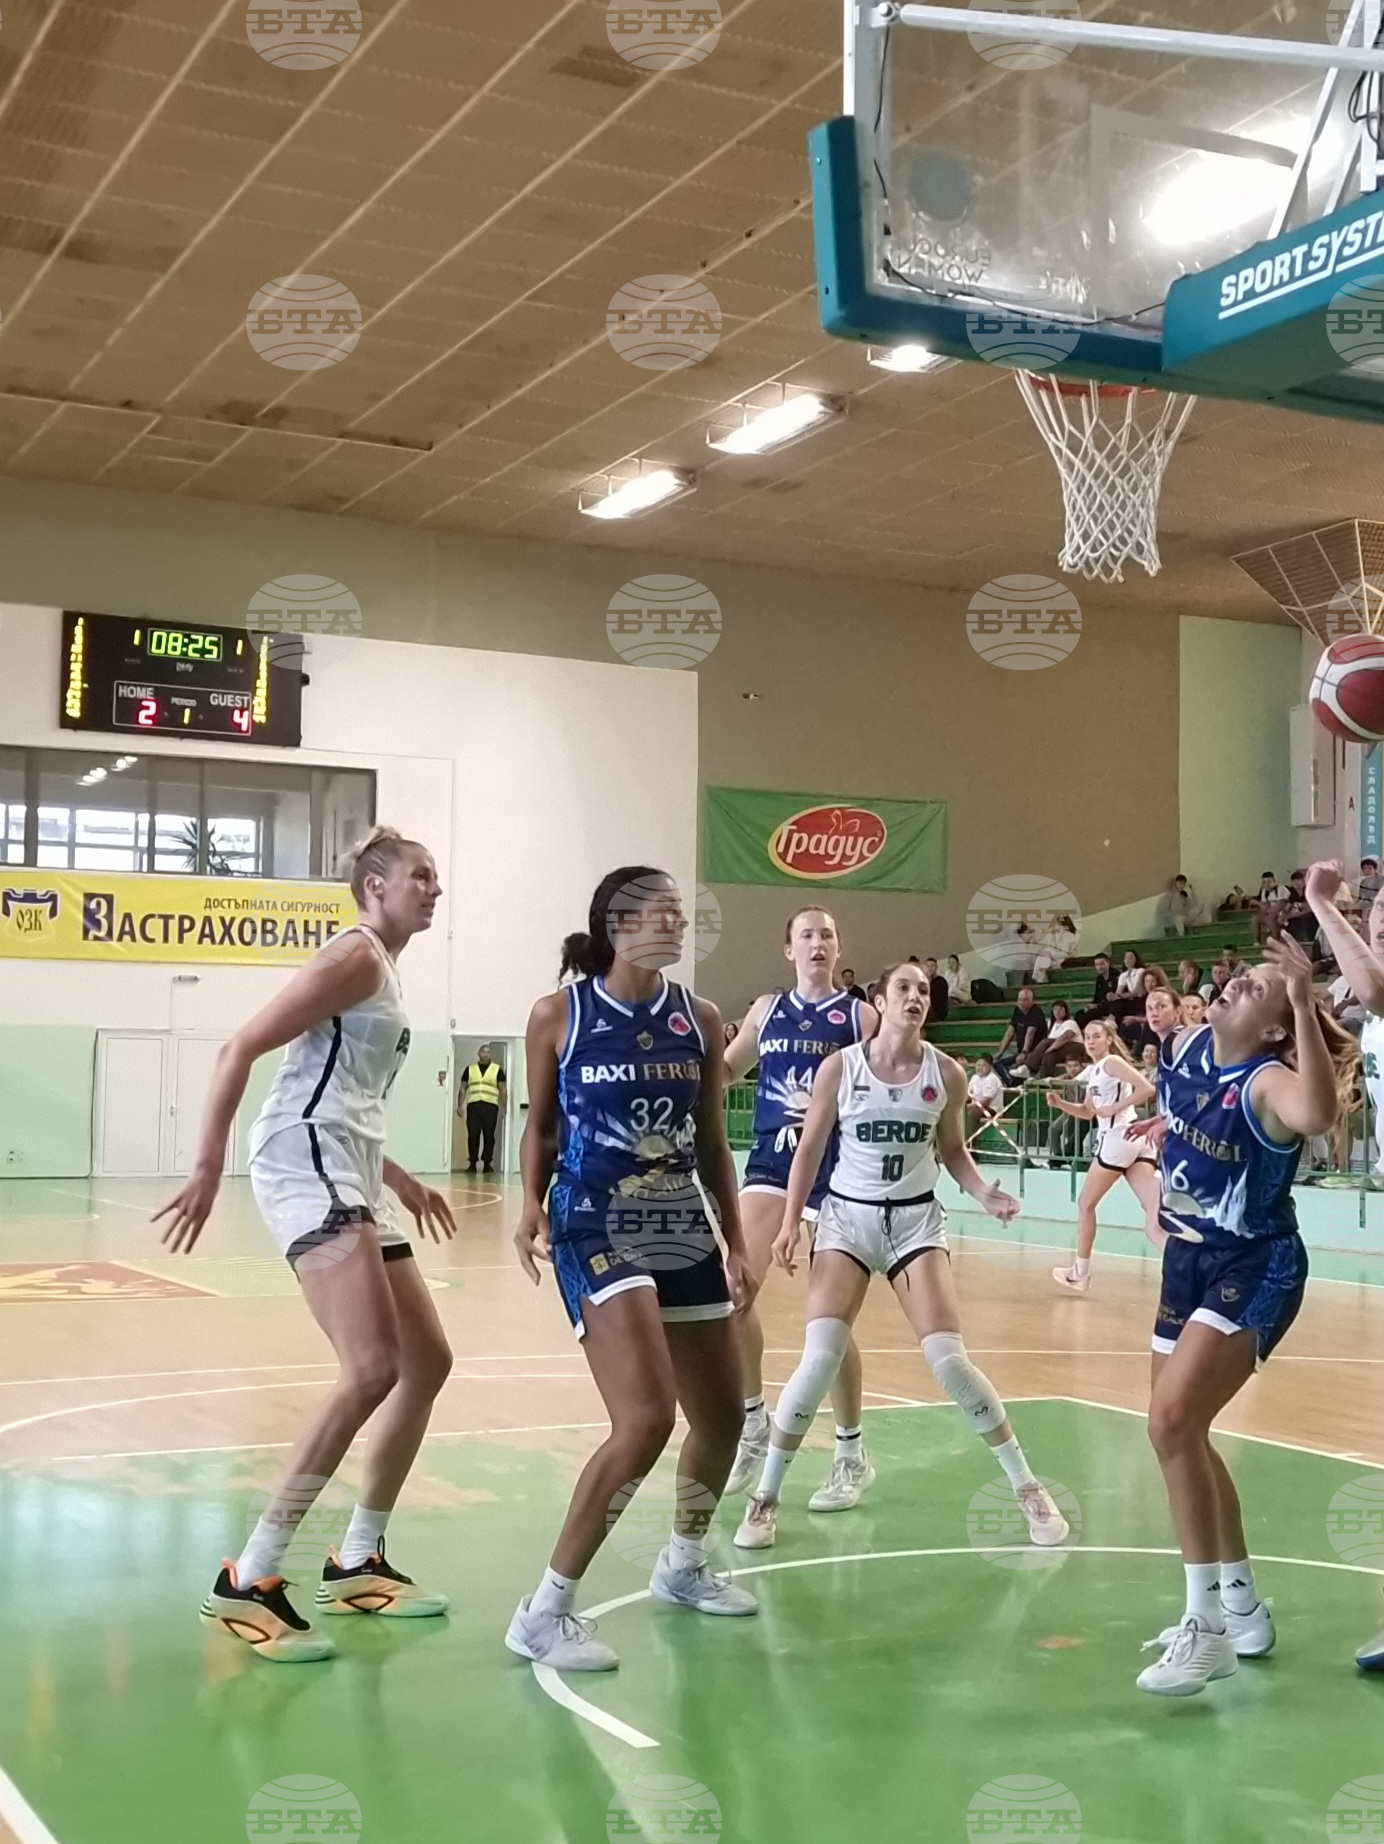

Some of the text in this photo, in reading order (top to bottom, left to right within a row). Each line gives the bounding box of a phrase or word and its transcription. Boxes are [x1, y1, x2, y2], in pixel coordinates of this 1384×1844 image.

[151, 631, 219, 659] 08:25
[118, 685, 155, 699] HOME
[210, 693, 250, 708] GUEST
[138, 700, 157, 725] 2
[233, 709, 250, 732] 4
[203, 897, 341, 914] ДОСТЪПНАТА СИГУРНОСТ
[580, 1064, 637, 1084] BAXI
[785, 1065, 813, 1093] 44
[630, 1096, 674, 1132] 32
[856, 1120, 932, 1144] BEROE
[881, 1154, 905, 1182] 10
[1170, 1159, 1190, 1192] 6
